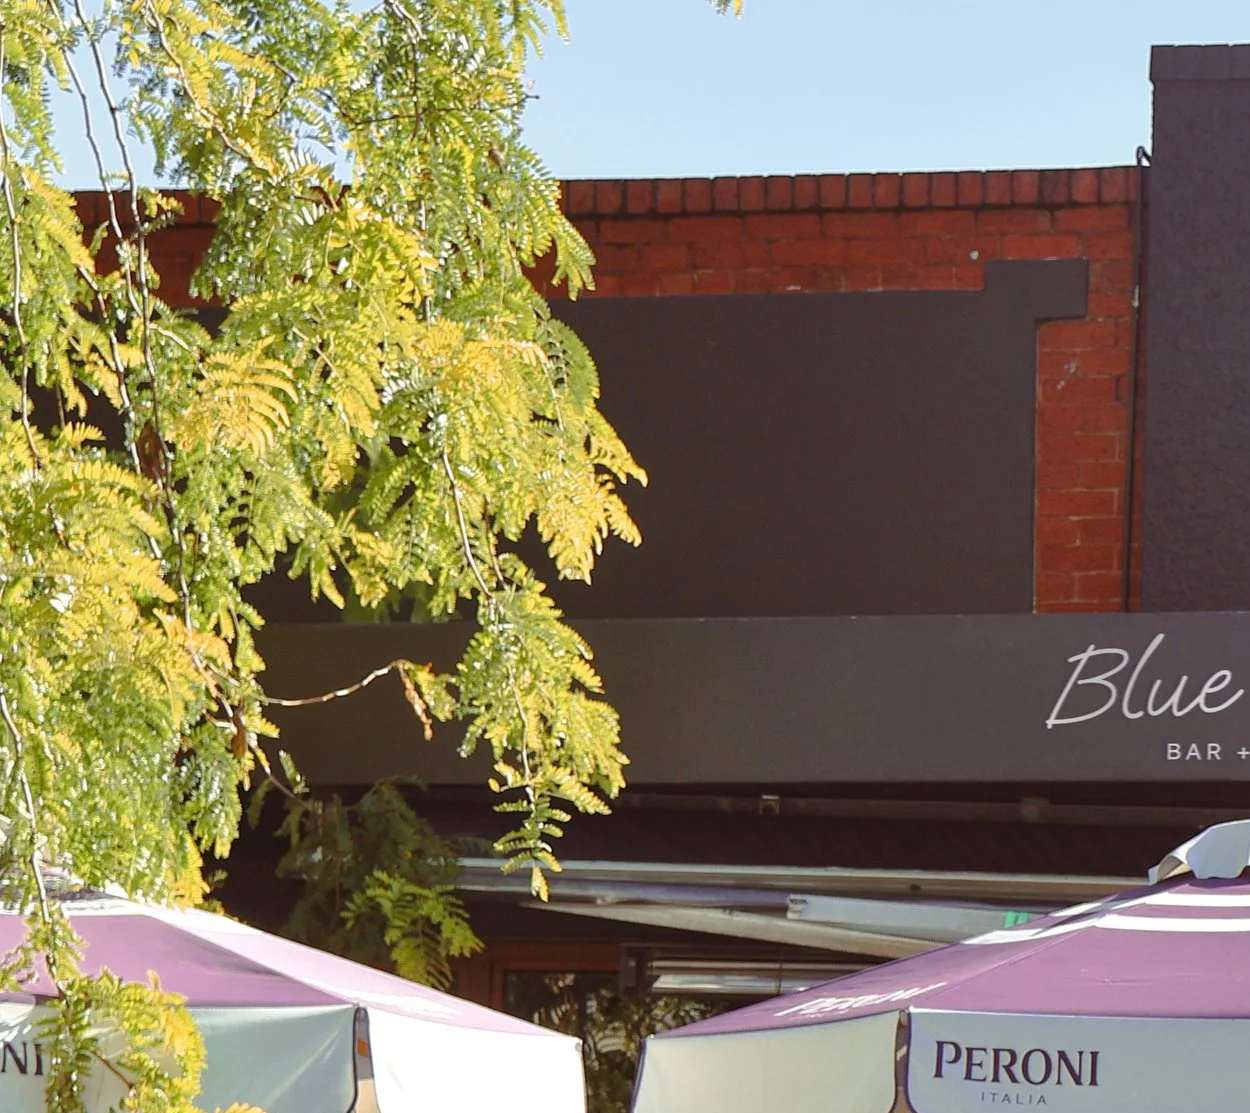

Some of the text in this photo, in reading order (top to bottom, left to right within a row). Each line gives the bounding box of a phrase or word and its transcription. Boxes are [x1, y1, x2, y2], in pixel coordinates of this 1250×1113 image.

[1045, 632, 1245, 730] Blue
[1166, 742, 1222, 761] BAR
[1236, 746, 1250, 760] +
[932, 1039, 1101, 1087] PERONI
[980, 1090, 1047, 1106] ITALIA
